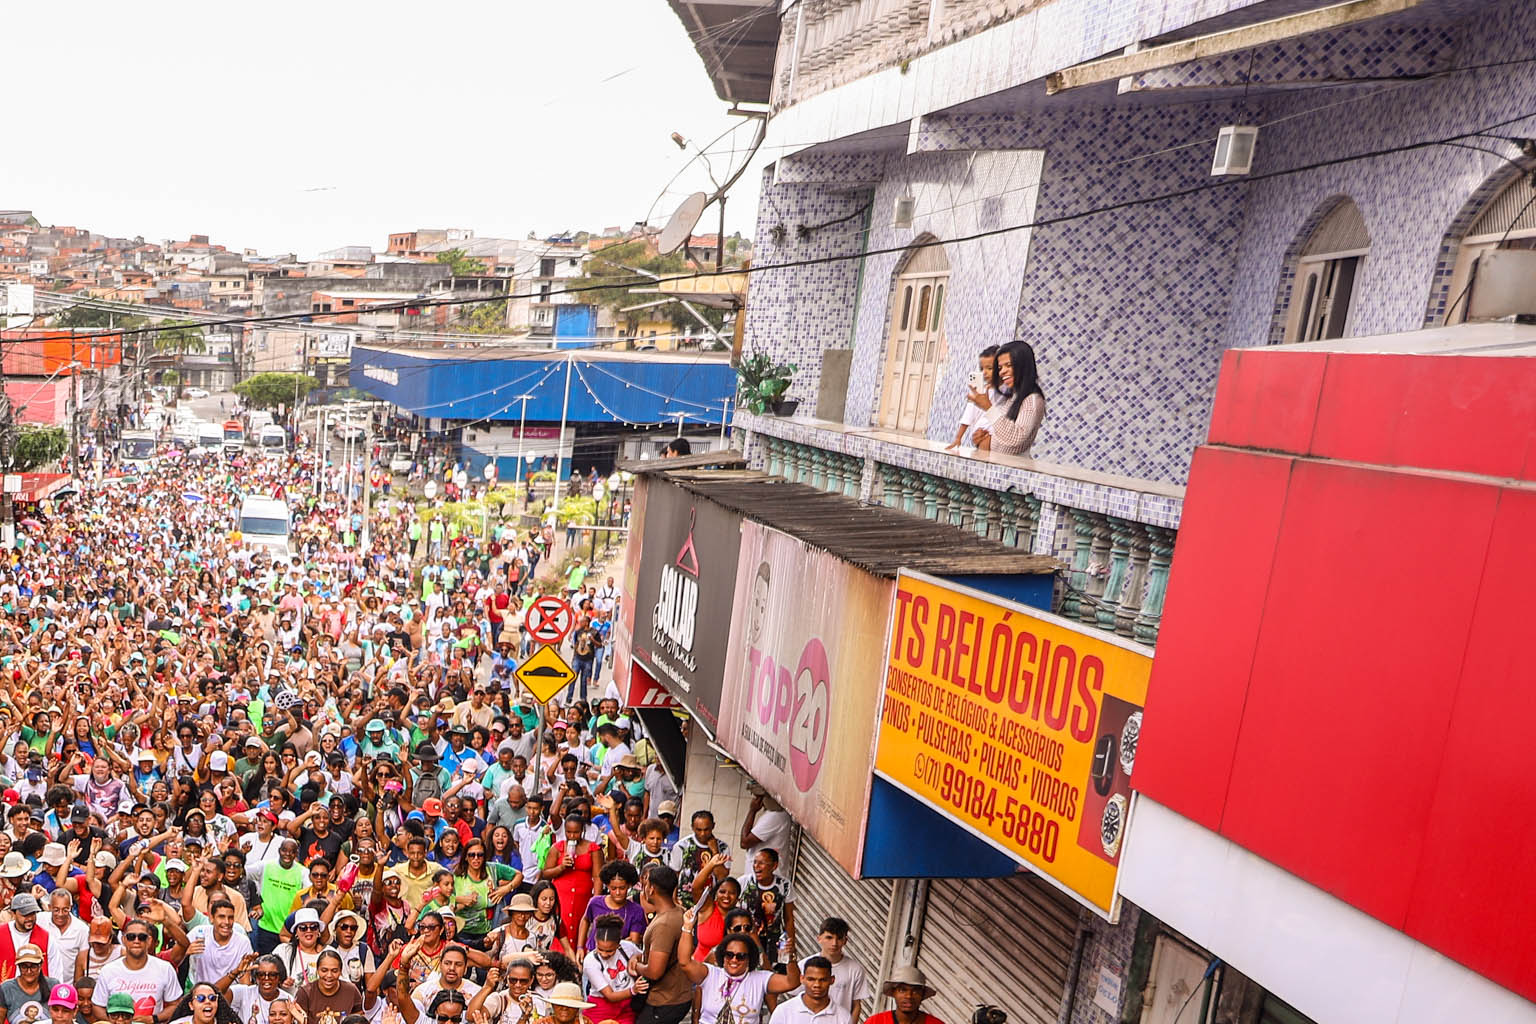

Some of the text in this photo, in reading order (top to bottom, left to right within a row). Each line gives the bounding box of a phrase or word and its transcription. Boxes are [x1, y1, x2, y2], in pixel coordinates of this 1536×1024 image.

[658, 563, 698, 653] COLLAB
[746, 646, 793, 736] TOP
[792, 667, 827, 766] 20
[886, 664, 1064, 773] CONSERTOS DE RELÓGIOS & ACESSÓRIOS
[894, 589, 1105, 745] TS RELÓGIOS
[883, 694, 1079, 822] PINOS PULSEIRAS PILHAS VIDROS
[924, 754, 1059, 864] (71) 99184-5880
